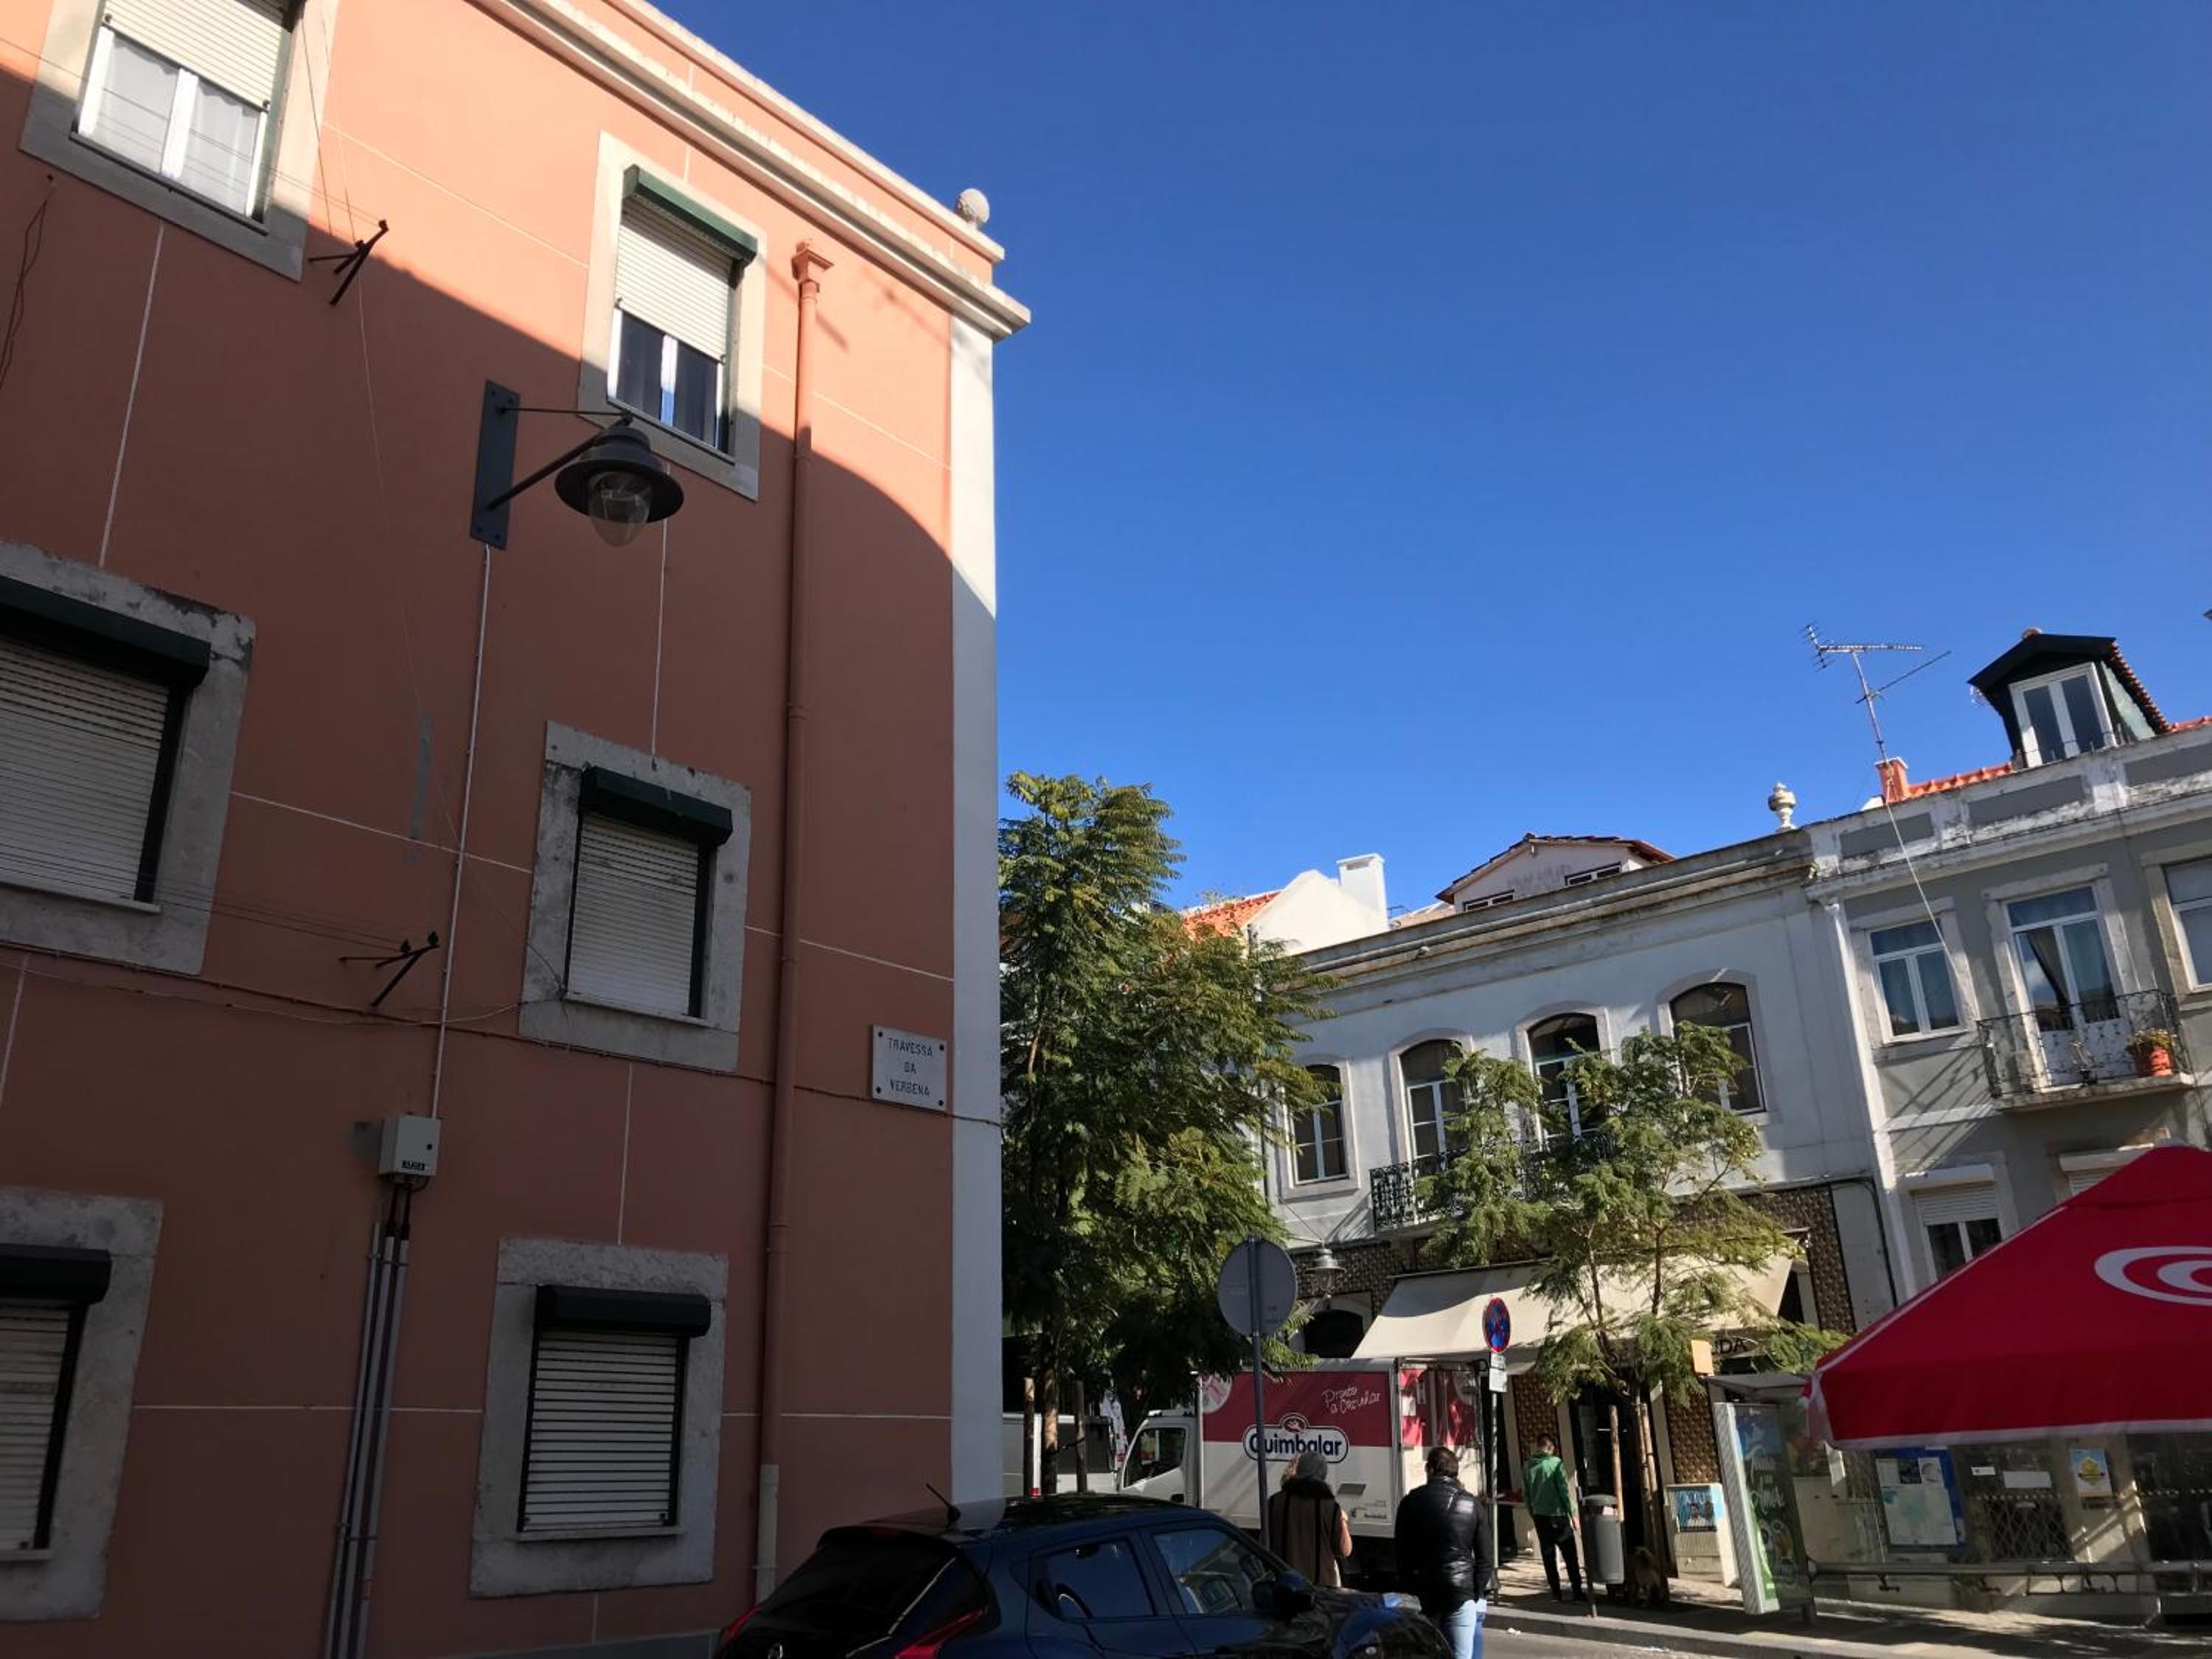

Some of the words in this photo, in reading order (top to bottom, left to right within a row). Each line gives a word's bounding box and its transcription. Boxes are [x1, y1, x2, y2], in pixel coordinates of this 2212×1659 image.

[888, 1037, 933, 1057] TRAVESSA
[903, 1061, 917, 1074] DA
[890, 1079, 931, 1097] VERBENA
